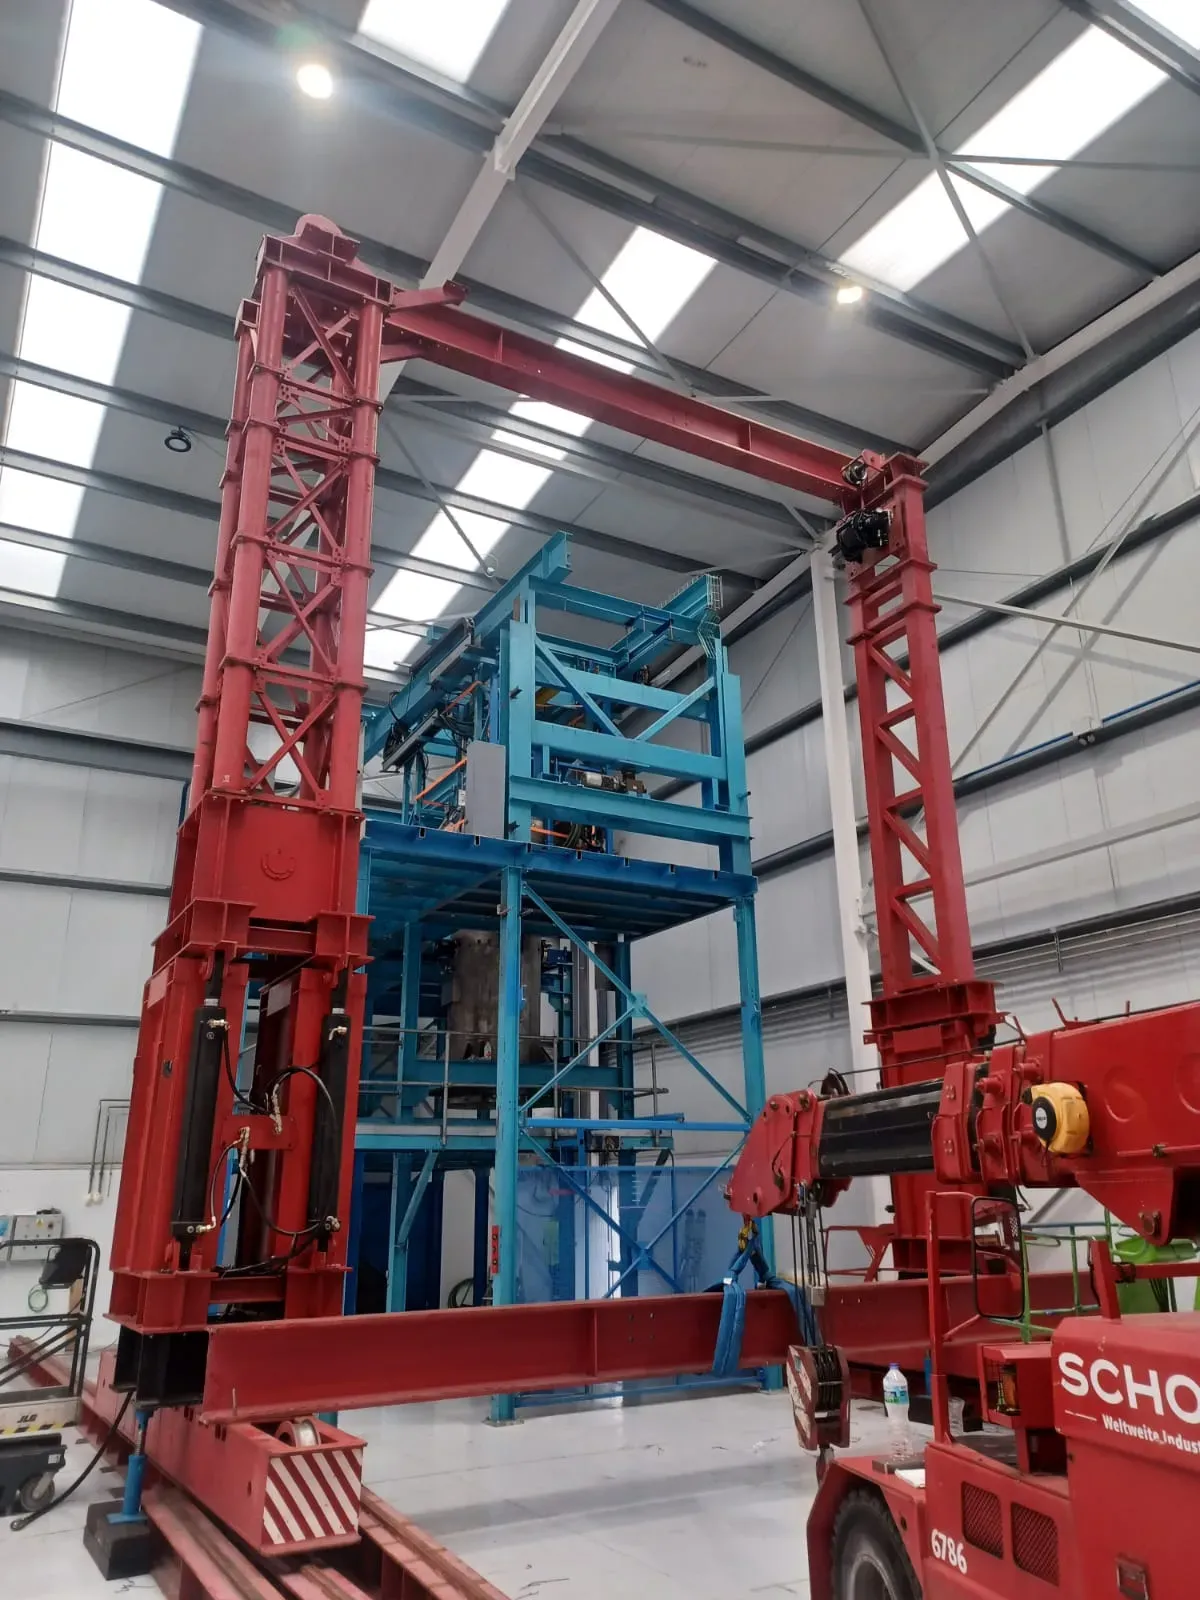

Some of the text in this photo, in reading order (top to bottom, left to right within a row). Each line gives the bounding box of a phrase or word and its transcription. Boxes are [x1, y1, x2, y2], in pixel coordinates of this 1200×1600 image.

[1058, 1352, 1200, 1424] SCHO
[1101, 1413, 1160, 1442] Weltweite
[931, 1528, 968, 1575] 6786
